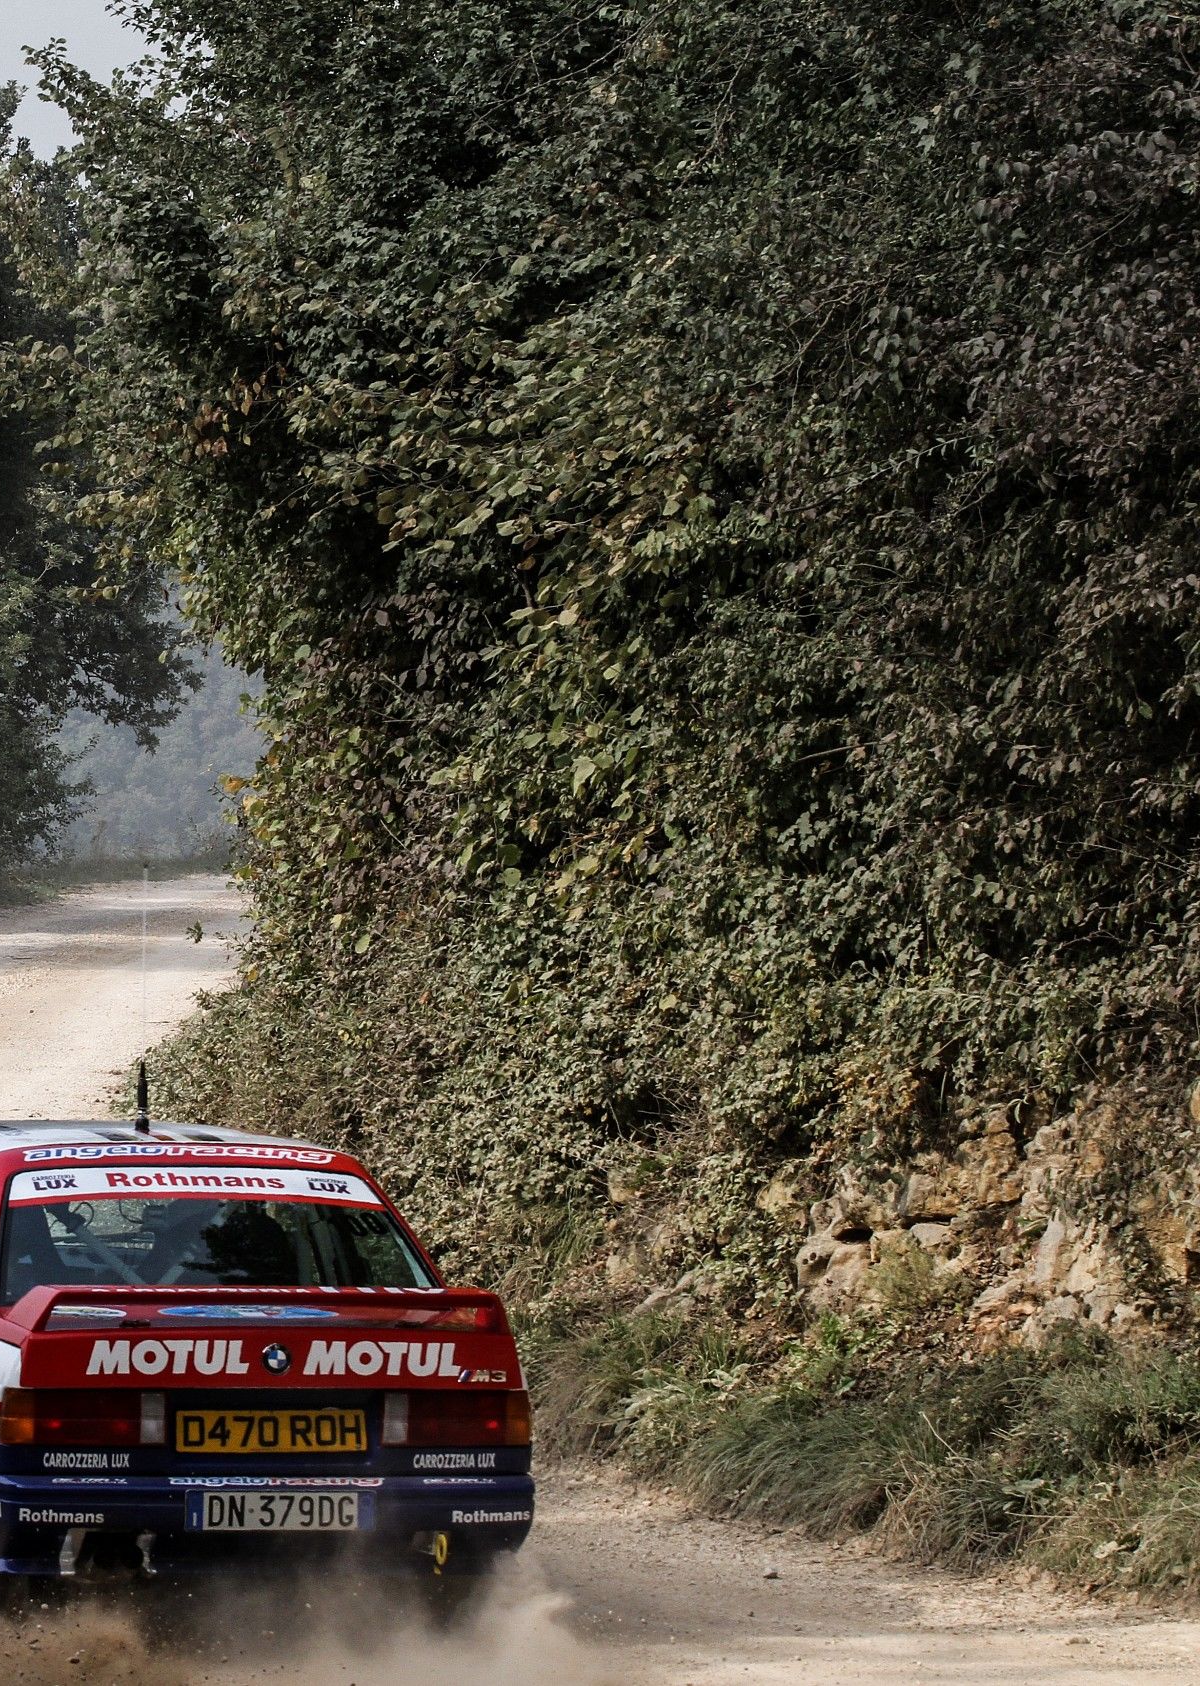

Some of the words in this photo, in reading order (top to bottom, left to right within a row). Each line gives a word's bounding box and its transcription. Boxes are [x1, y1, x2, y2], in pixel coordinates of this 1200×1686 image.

[33, 1178, 79, 1191] LUX
[105, 1172, 285, 1189] Rothmans
[307, 1181, 352, 1195] LUX
[86, 1340, 250, 1375] MOTUL
[303, 1340, 461, 1377] MOTUL
[471, 1369, 507, 1383] M3
[183, 1415, 279, 1448] D470
[290, 1413, 362, 1448] ROH
[43, 1453, 108, 1469] CARROZZERIA
[111, 1453, 130, 1468] LUX
[413, 1453, 475, 1469] CARROZZERIA
[477, 1453, 496, 1468] LUX
[18, 1508, 105, 1524] Rothmans
[208, 1494, 246, 1528] DN
[258, 1494, 355, 1528] 379DG
[452, 1510, 531, 1524] Rothmans
